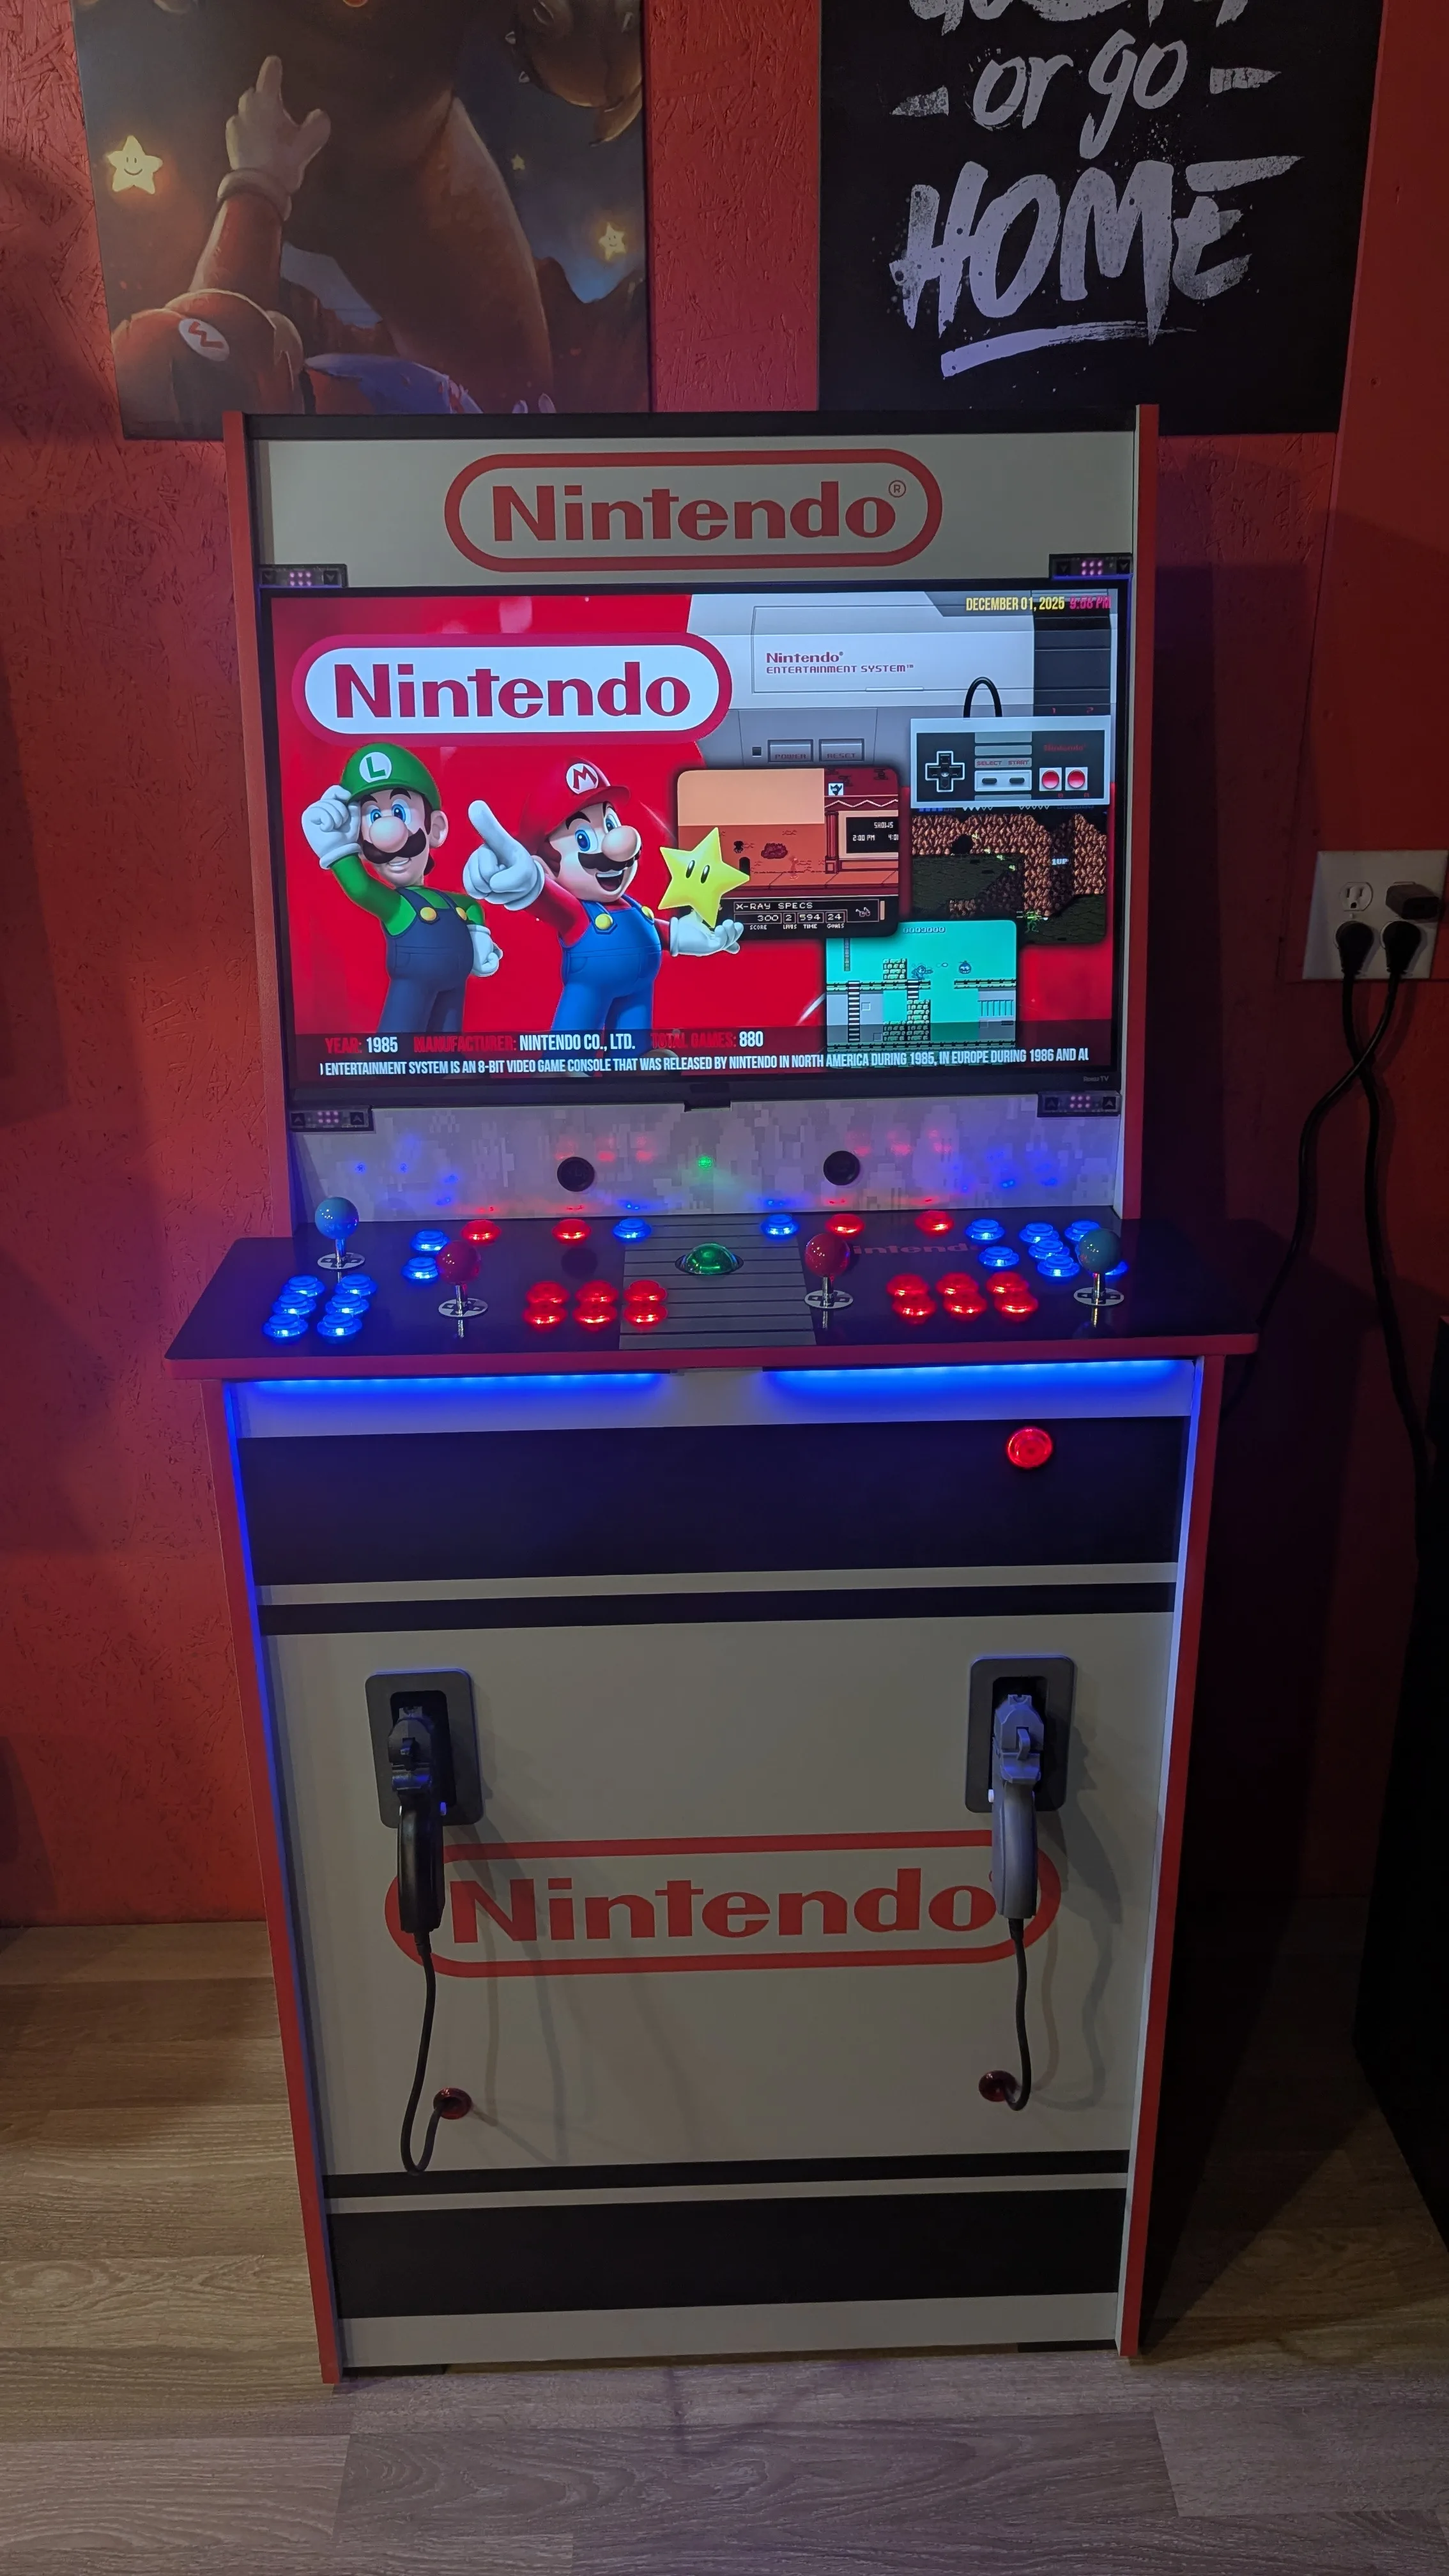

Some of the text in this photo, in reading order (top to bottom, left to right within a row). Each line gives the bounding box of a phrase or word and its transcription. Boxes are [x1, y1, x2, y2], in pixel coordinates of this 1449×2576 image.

[971, 28, 1188, 160] or go
[889, 155, 1305, 346] HOME
[965, 597, 1019, 611] DECEMBER
[1020, 597, 1037, 612] 01,
[1038, 595, 1066, 611] 2025
[766, 665, 857, 675] ENTERTAINMENT
[334, 661, 691, 719] Nintendo
[325, 1036, 398, 1054] YEAR: 1985
[413, 1033, 636, 1053] MANUFACTURER: NINTENDO CO., LTD.
[650, 1031, 763, 1049] TOTAL GAMES: 880
[325, 1061, 408, 1076] ENTERTAINMENT
[408, 1061, 448, 1075] SYSTEM
[450, 1061, 461, 1073] IS
[462, 1060, 476, 1073] AN
[477, 1060, 505, 1073] 8-BIT
[506, 1059, 535, 1073] VIDEO
[537, 1059, 566, 1073] GAME
[567, 1059, 611, 1072] CONSOLE
[612, 1058, 639, 1071] THAT
[640, 1057, 662, 1071] WAS
[664, 1056, 712, 1071] RELEASED
[714, 1056, 728, 1070] BY
[729, 1055, 778, 1070] NINTENDO
[779, 1055, 790, 1068] IN
[791, 1054, 824, 1068] NORTH
[825, 1053, 870, 1068] AMERICA
[871, 1052, 907, 1066] DURING
[910, 1051, 938, 1066] 1985,
[939, 1052, 949, 1065] IN
[951, 1050, 989, 1064] EUROPE
[990, 1050, 1027, 1063] DURING
[1029, 1048, 1054, 1062] 1986
[1056, 1048, 1077, 1062] AND
[852, 1243, 982, 1255] intend
